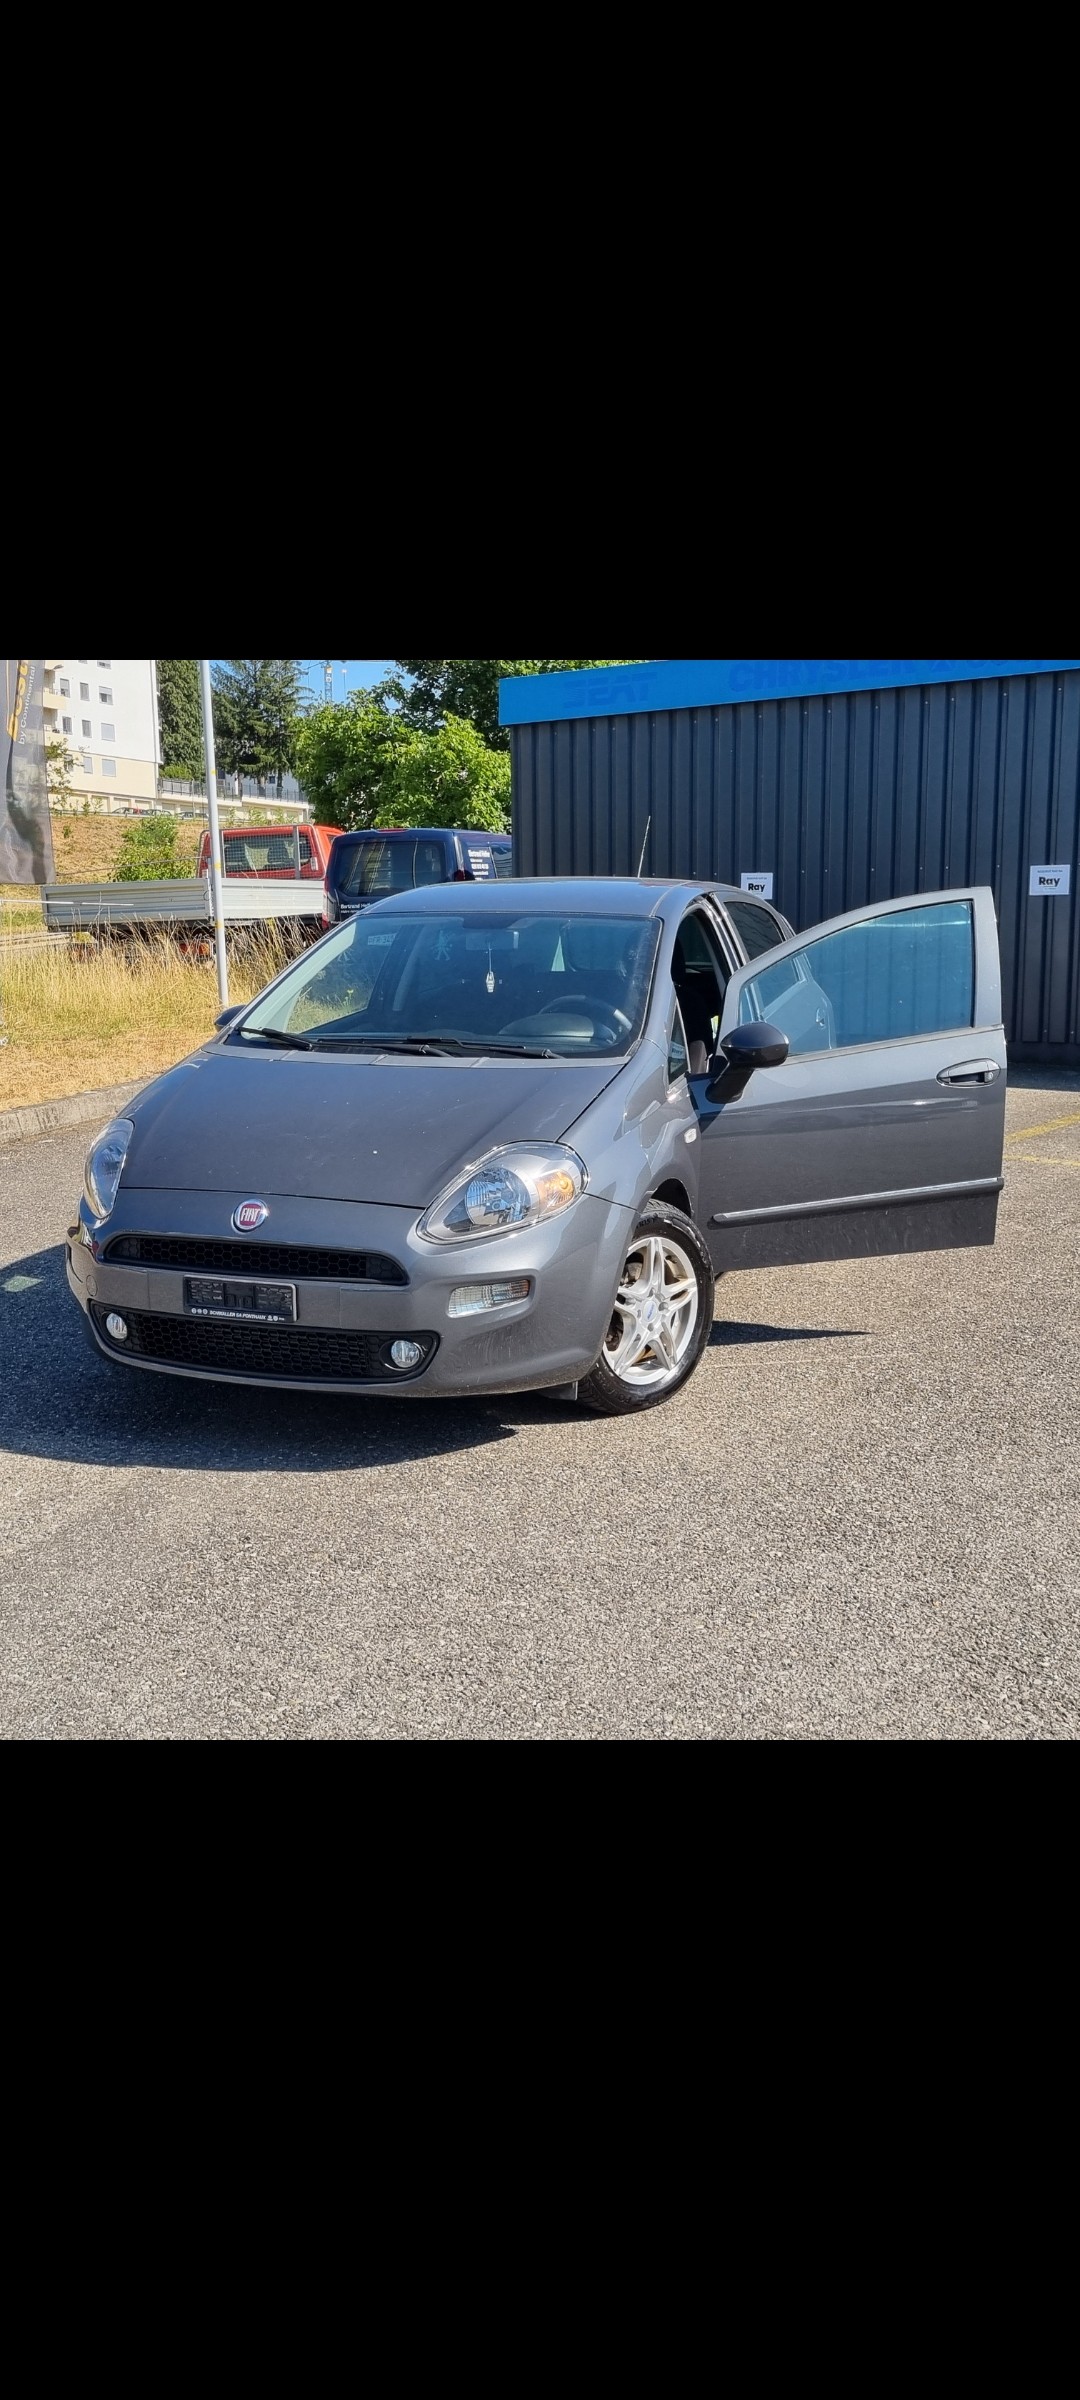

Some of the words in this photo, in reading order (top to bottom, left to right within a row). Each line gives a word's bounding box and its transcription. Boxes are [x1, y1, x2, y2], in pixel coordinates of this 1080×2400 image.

[563, 671, 658, 708] SEAT
[21, 666, 36, 728] Continental
[18, 731, 26, 744] by
[748, 883, 765, 892] Ray
[1039, 876, 1060, 887] Ray
[241, 1208, 260, 1221] FIAT
